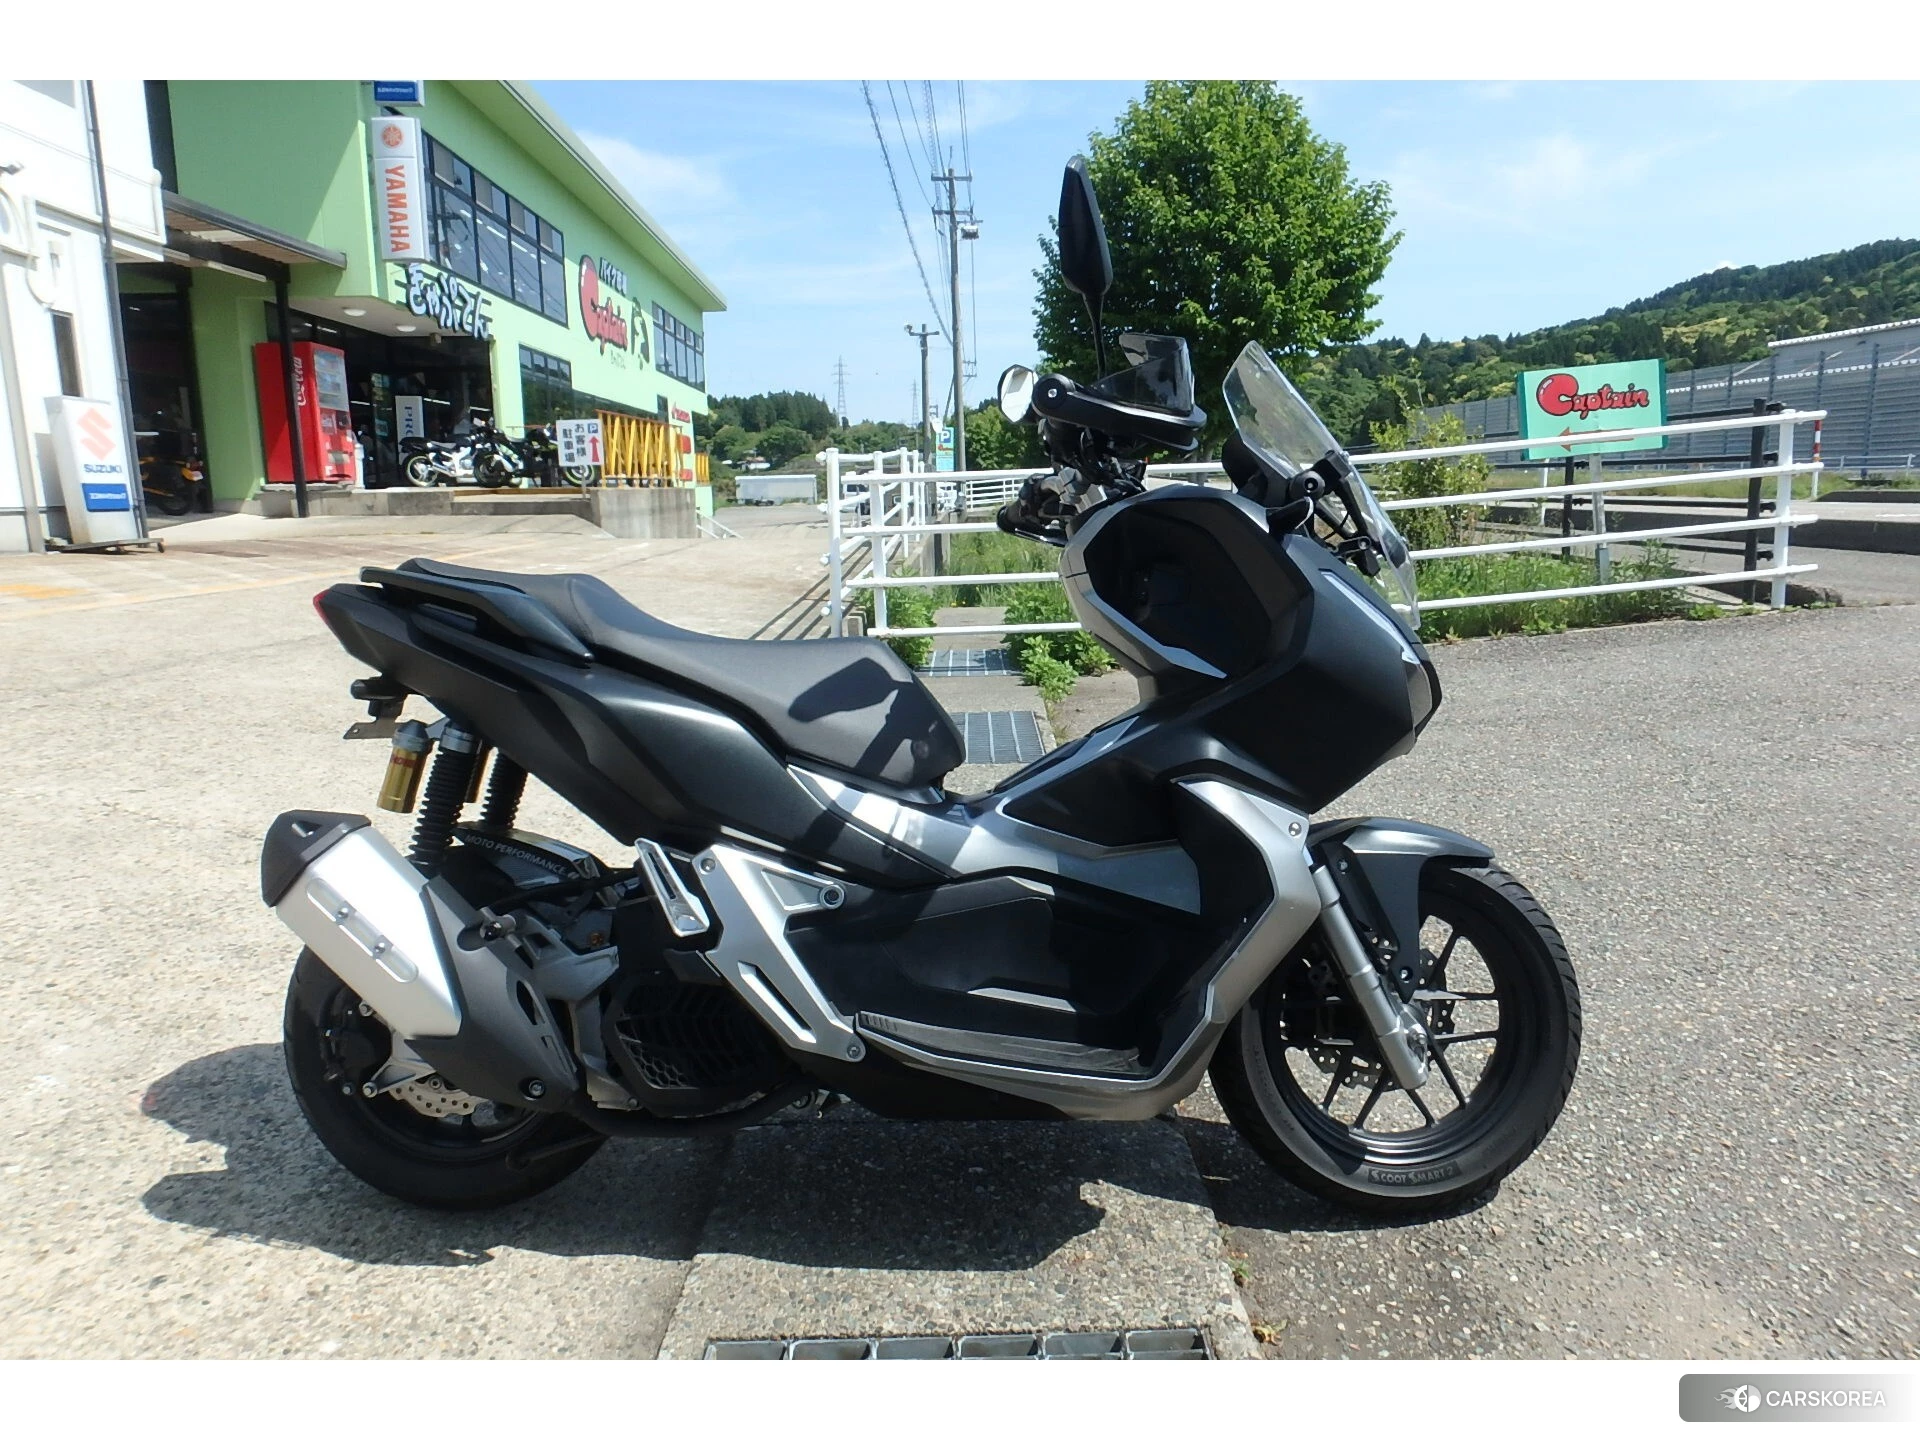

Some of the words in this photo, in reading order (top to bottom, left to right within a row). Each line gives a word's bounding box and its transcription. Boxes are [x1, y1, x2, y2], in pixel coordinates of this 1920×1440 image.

[384, 164, 411, 253] YAMAHA
[1536, 373, 1650, 420] Captain
[562, 428, 576, 463] 駐車場
[574, 423, 587, 457] お客様
[465, 834, 494, 849] MOTO
[494, 844, 567, 875] PERFORMANCE
[1371, 1169, 1407, 1184] SCOOT
[1408, 1169, 1445, 1184] SMART
[1446, 1166, 1454, 1176] 2
